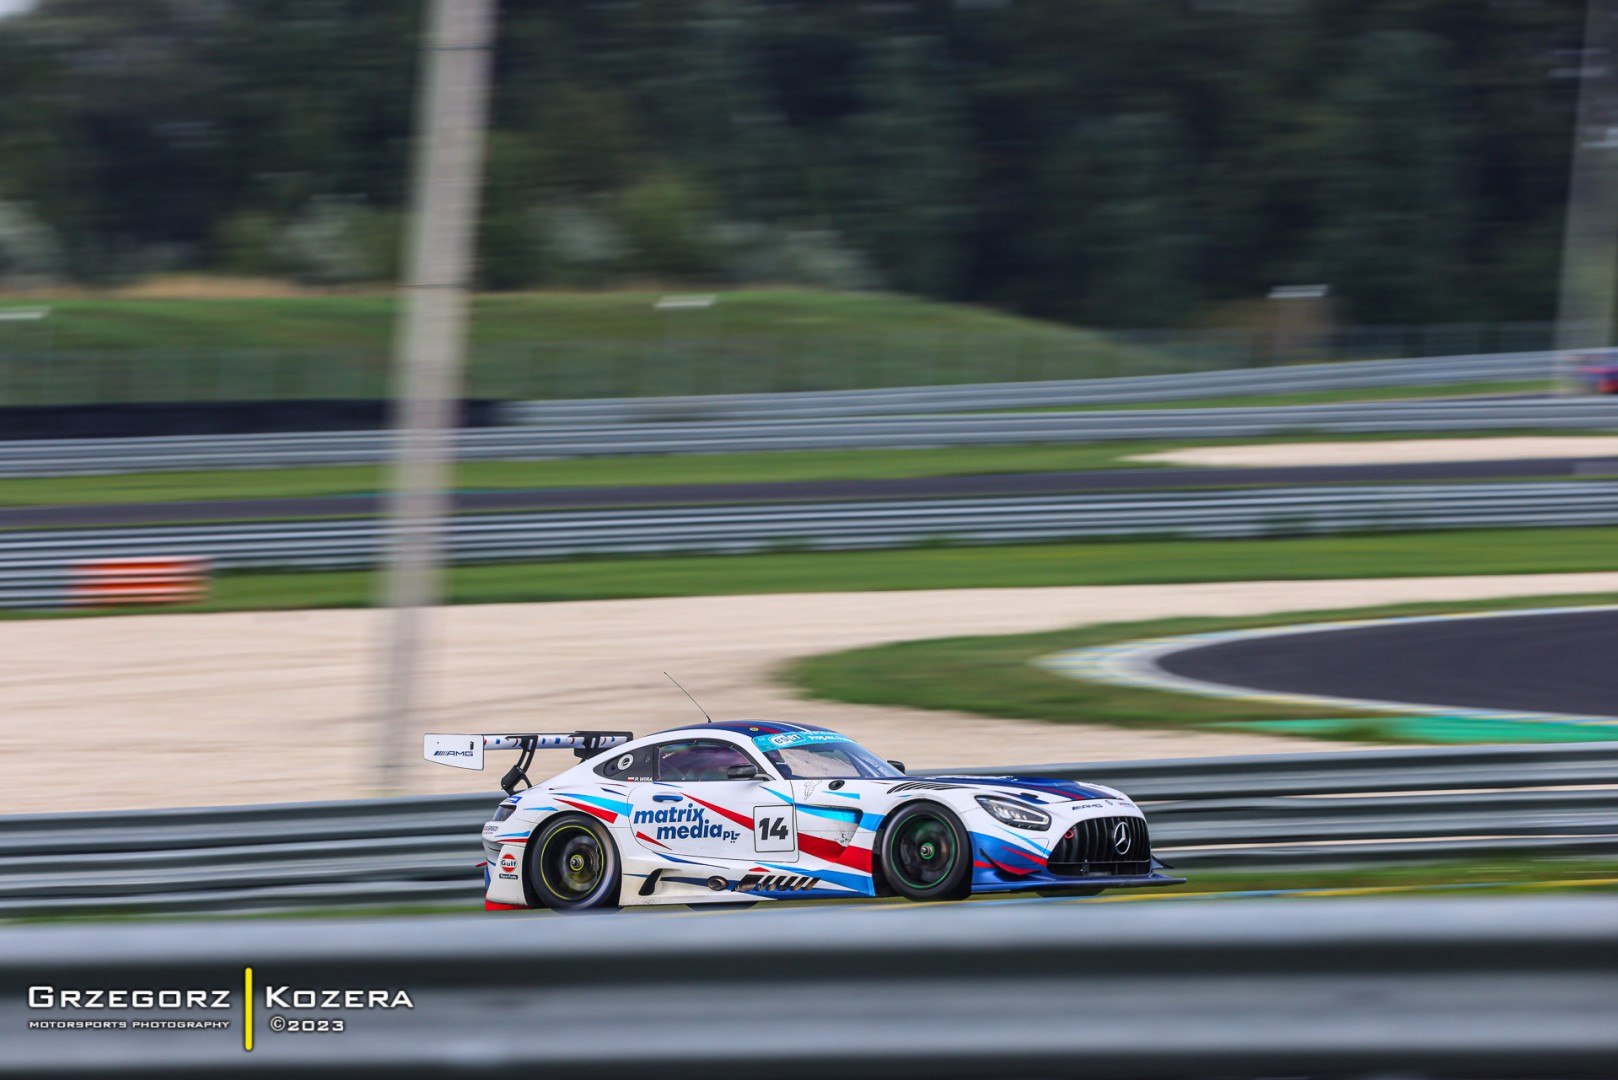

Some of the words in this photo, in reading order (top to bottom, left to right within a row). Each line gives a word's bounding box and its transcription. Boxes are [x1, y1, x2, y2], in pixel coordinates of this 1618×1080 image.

[633, 803, 705, 825] matrix
[656, 819, 723, 840] media
[758, 817, 789, 841] 14
[501, 859, 516, 867] Gulf
